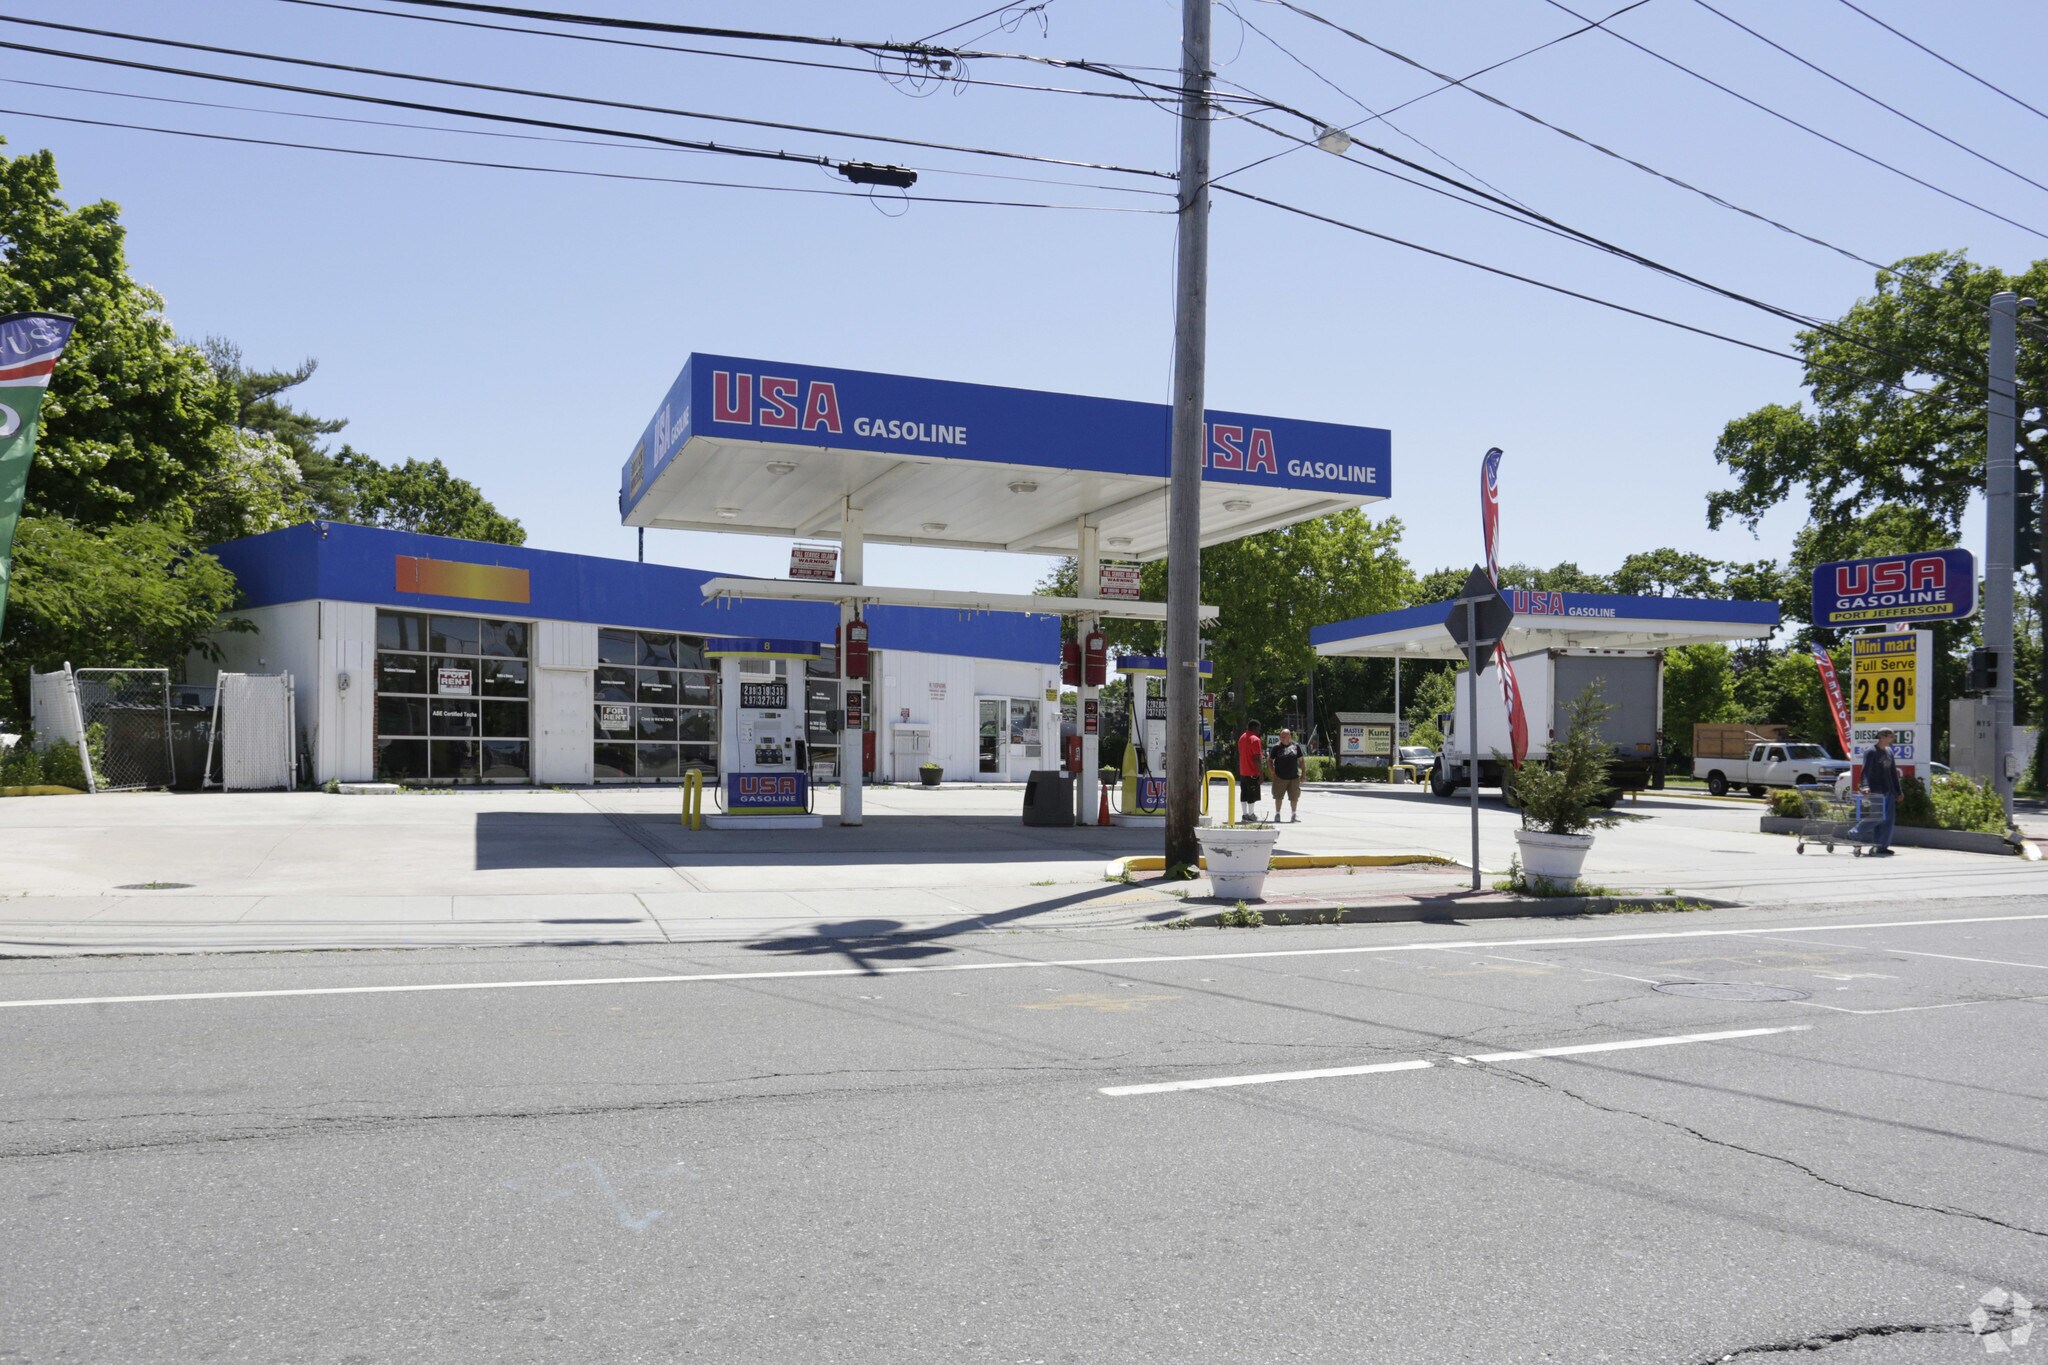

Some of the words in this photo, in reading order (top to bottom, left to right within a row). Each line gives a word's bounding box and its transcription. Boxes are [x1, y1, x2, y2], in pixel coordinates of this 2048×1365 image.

[713, 370, 843, 433] USA
[853, 417, 967, 445] GASOLINE
[1202, 423, 1278, 474] SA
[1287, 459, 1376, 484] GASOLINE
[1836, 557, 1946, 597] USA
[1513, 591, 1564, 615] USA
[1568, 607, 1616, 617] GASOLINE
[1836, 590, 1946, 609] GASOLINE
[1834, 611, 1867, 620] PORT
[1872, 605, 1948, 617] JEFFERSON
[764, 641, 771, 651] 8
[1855, 639, 1880, 654] Mini
[1885, 636, 1915, 651] mart
[1856, 661, 1877, 671] Full
[1881, 659, 1915, 670] Serve
[1857, 677, 1906, 711] 2.89
[1855, 730, 1879, 740] DIESE
[740, 777, 797, 794] USA
